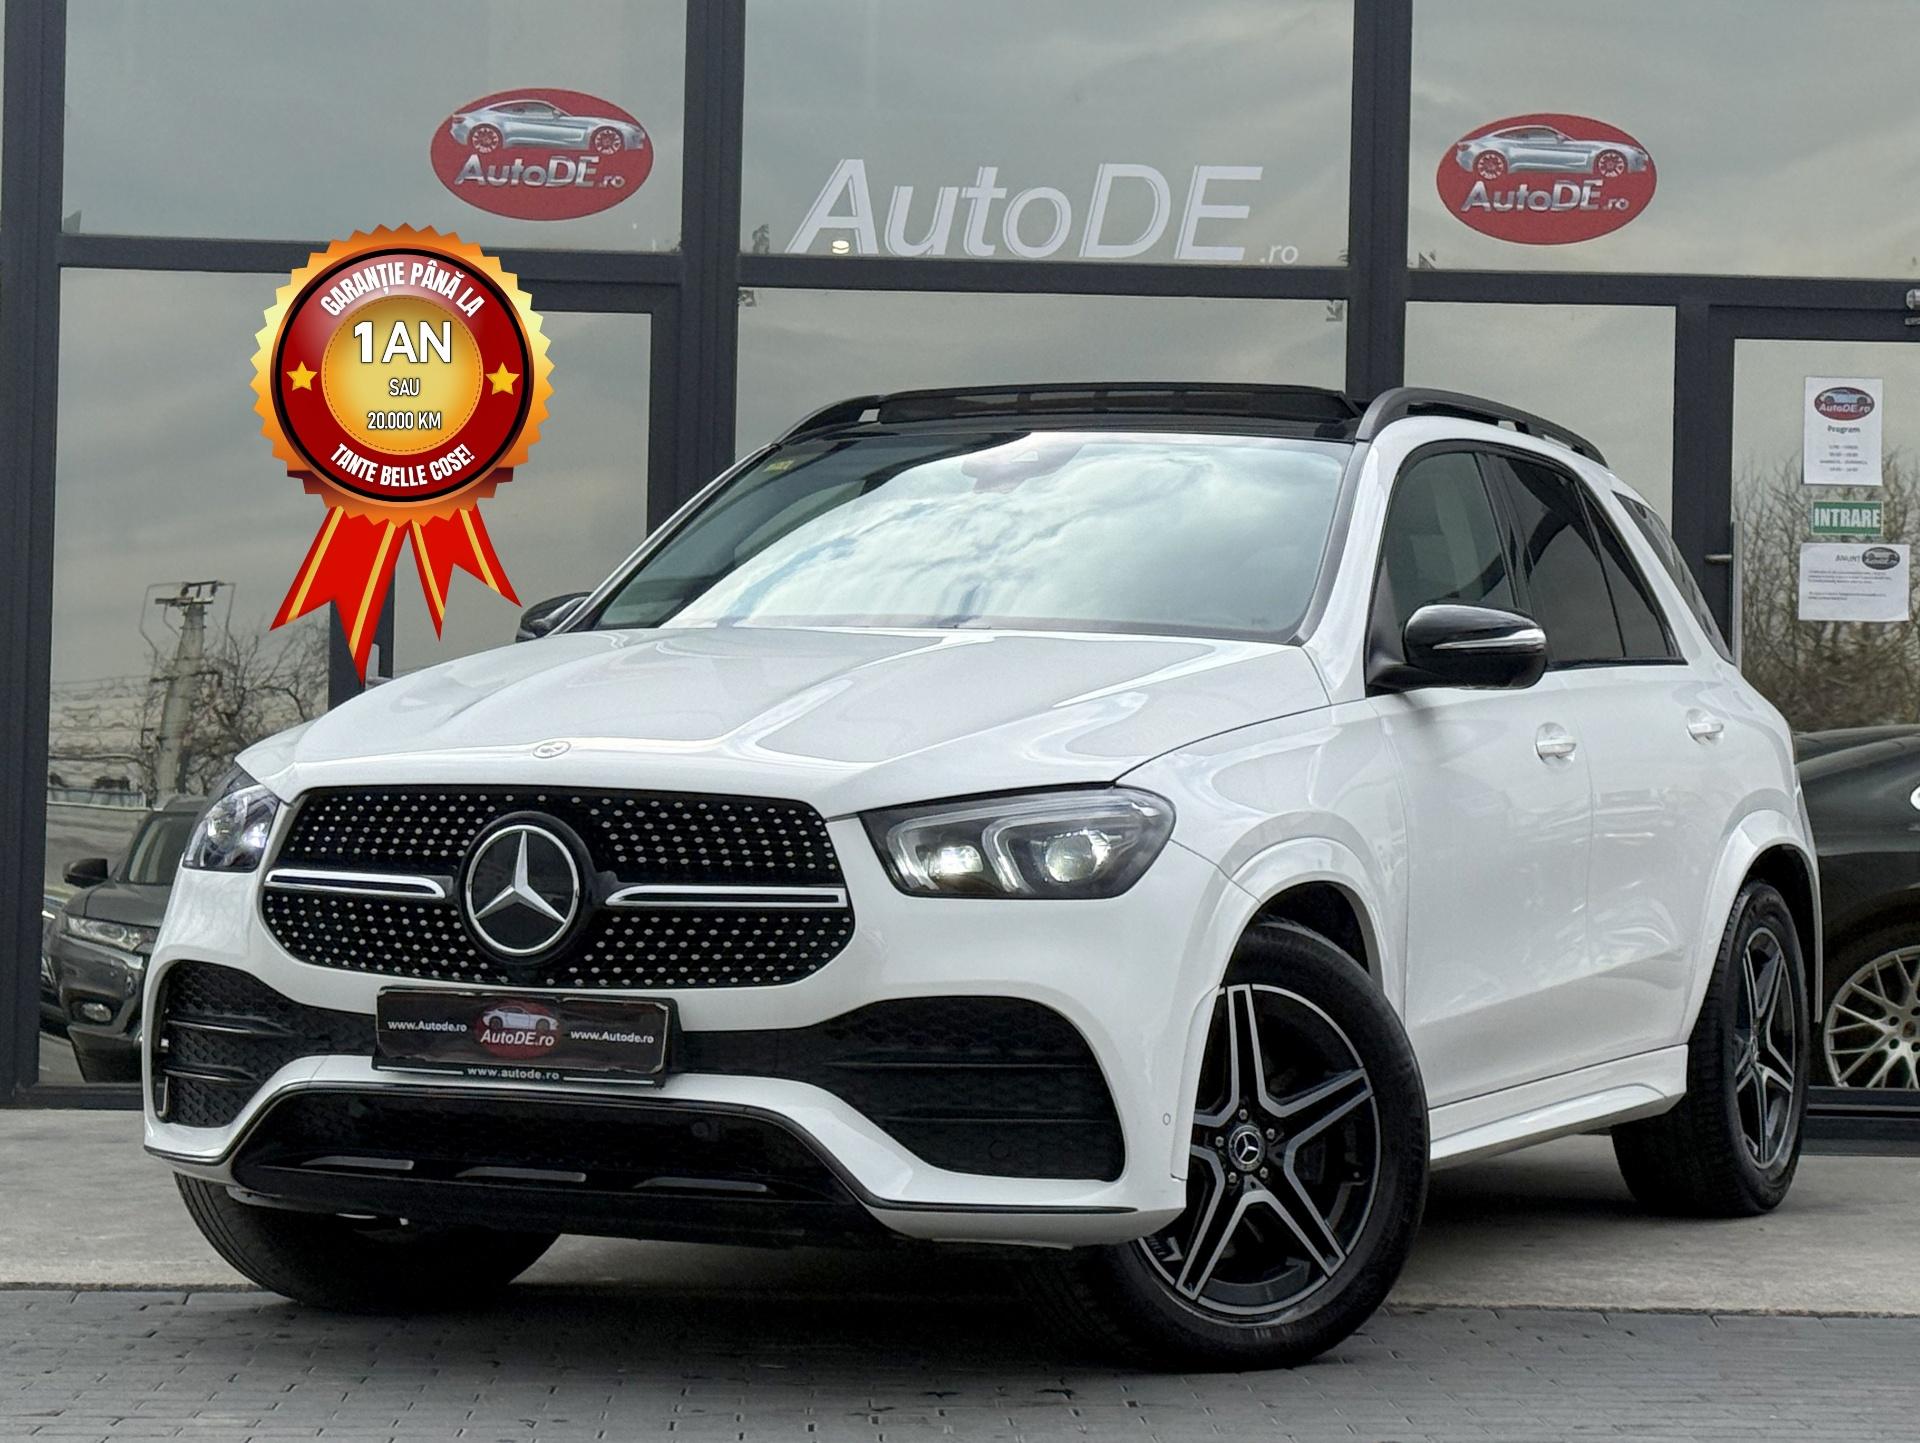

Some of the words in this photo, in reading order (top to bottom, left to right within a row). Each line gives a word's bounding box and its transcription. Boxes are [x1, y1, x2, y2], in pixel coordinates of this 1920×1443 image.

[1814, 508, 1881, 528] INTRARE
[387, 1019, 468, 1033] www.Autode.ro
[480, 1028, 555, 1047] AutoDE.ro
[570, 1028, 654, 1044] www.Autode.ro
[466, 1066, 560, 1081] www.autode.ro
